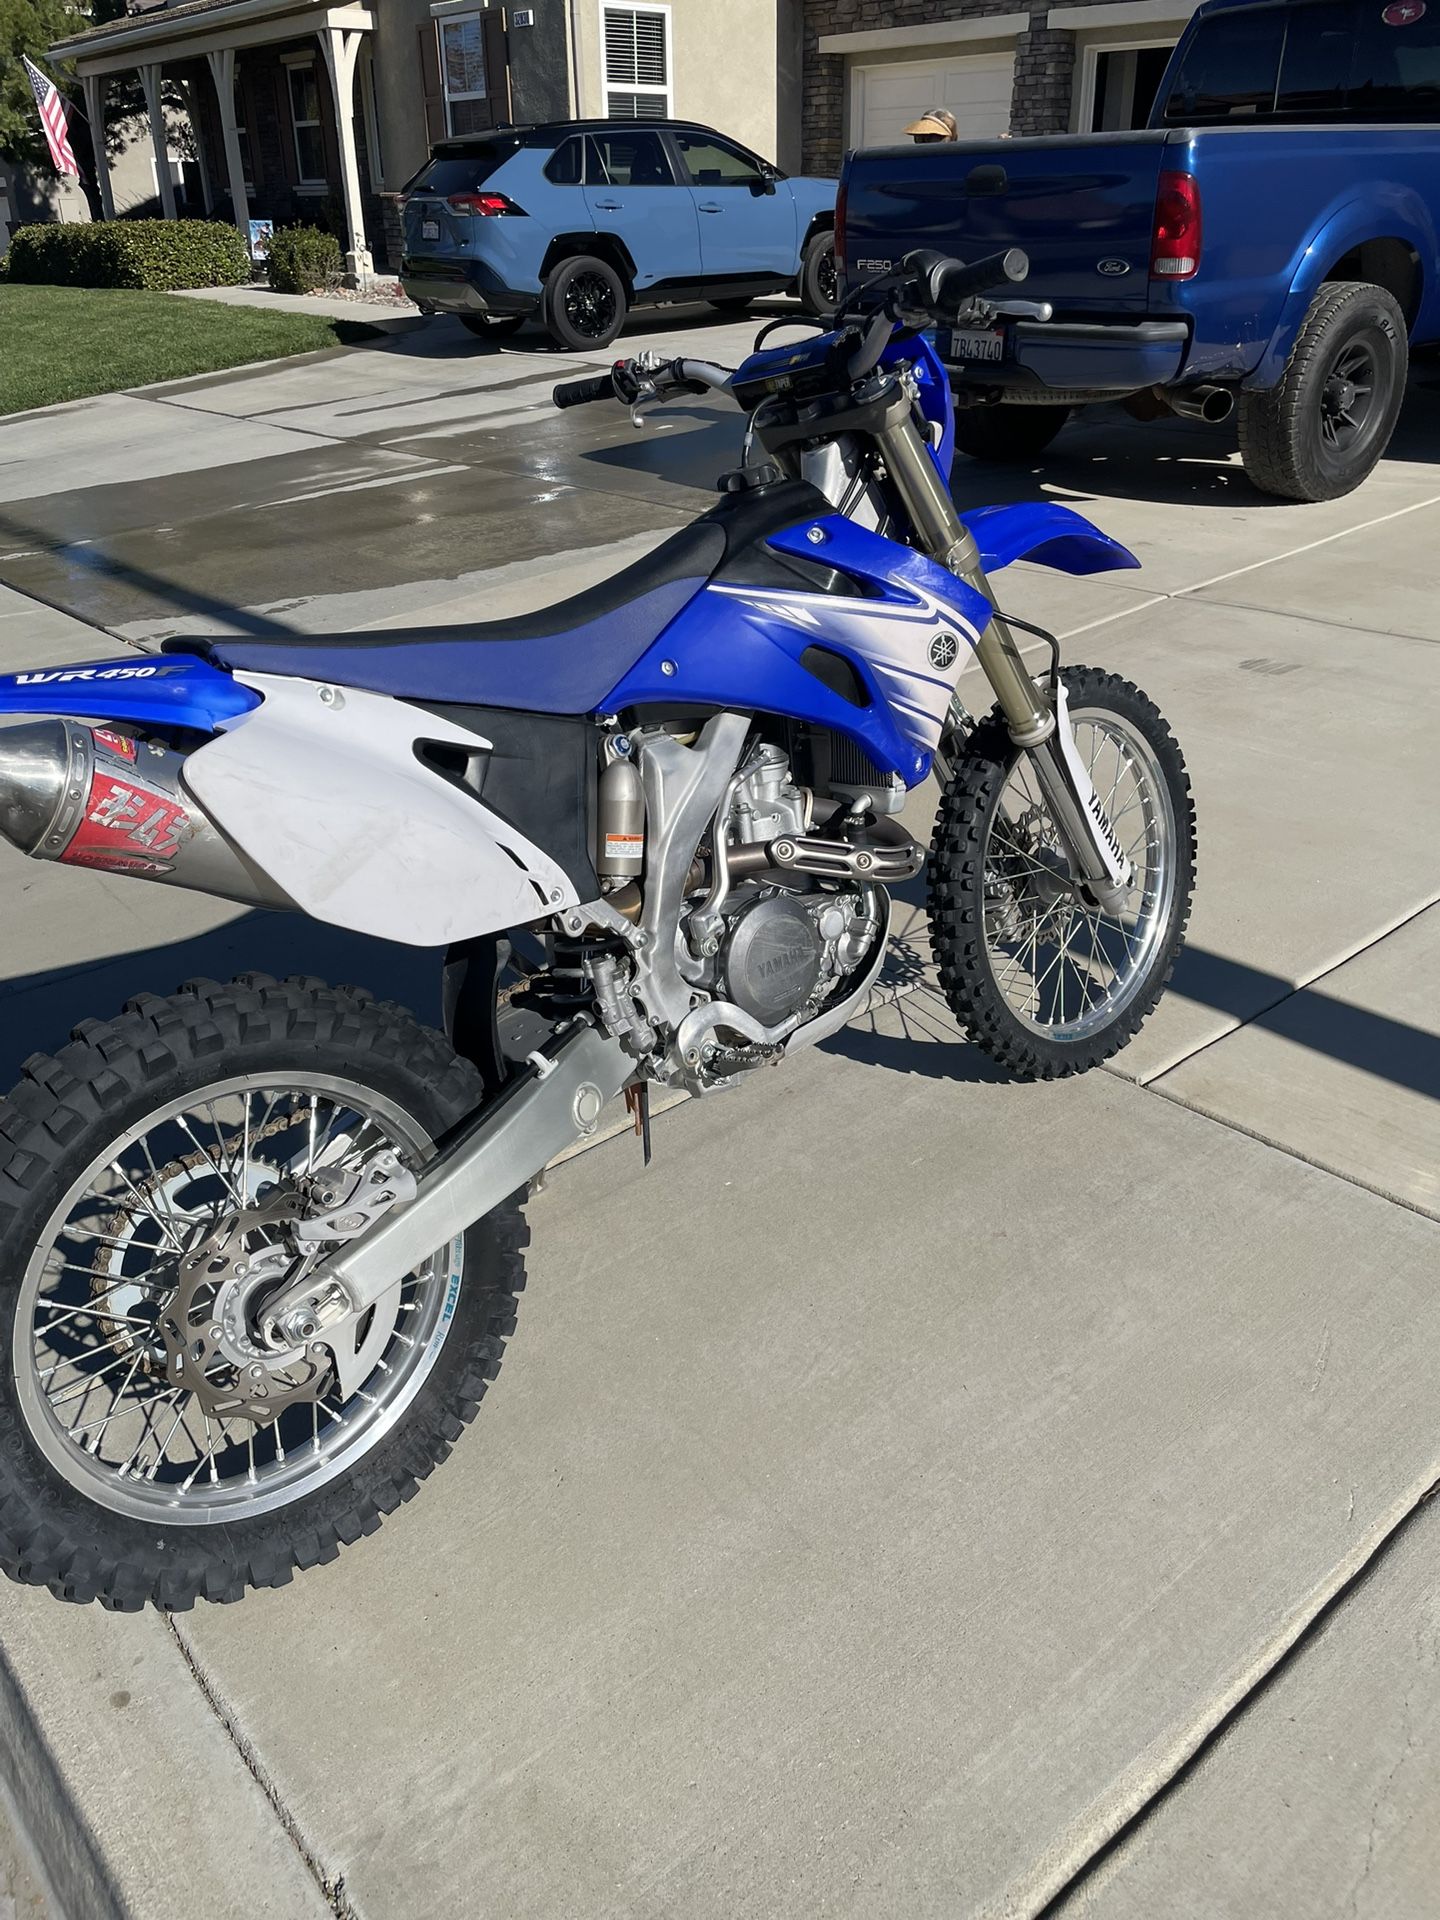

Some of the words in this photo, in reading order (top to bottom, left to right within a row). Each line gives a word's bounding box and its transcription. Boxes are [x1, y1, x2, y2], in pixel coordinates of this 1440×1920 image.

[953, 337, 1001, 360] 7B43740
[1088, 787, 1125, 870] YAMAHA
[757, 946, 804, 979] YAMAHA
[441, 1274, 460, 1321] EXCEL
